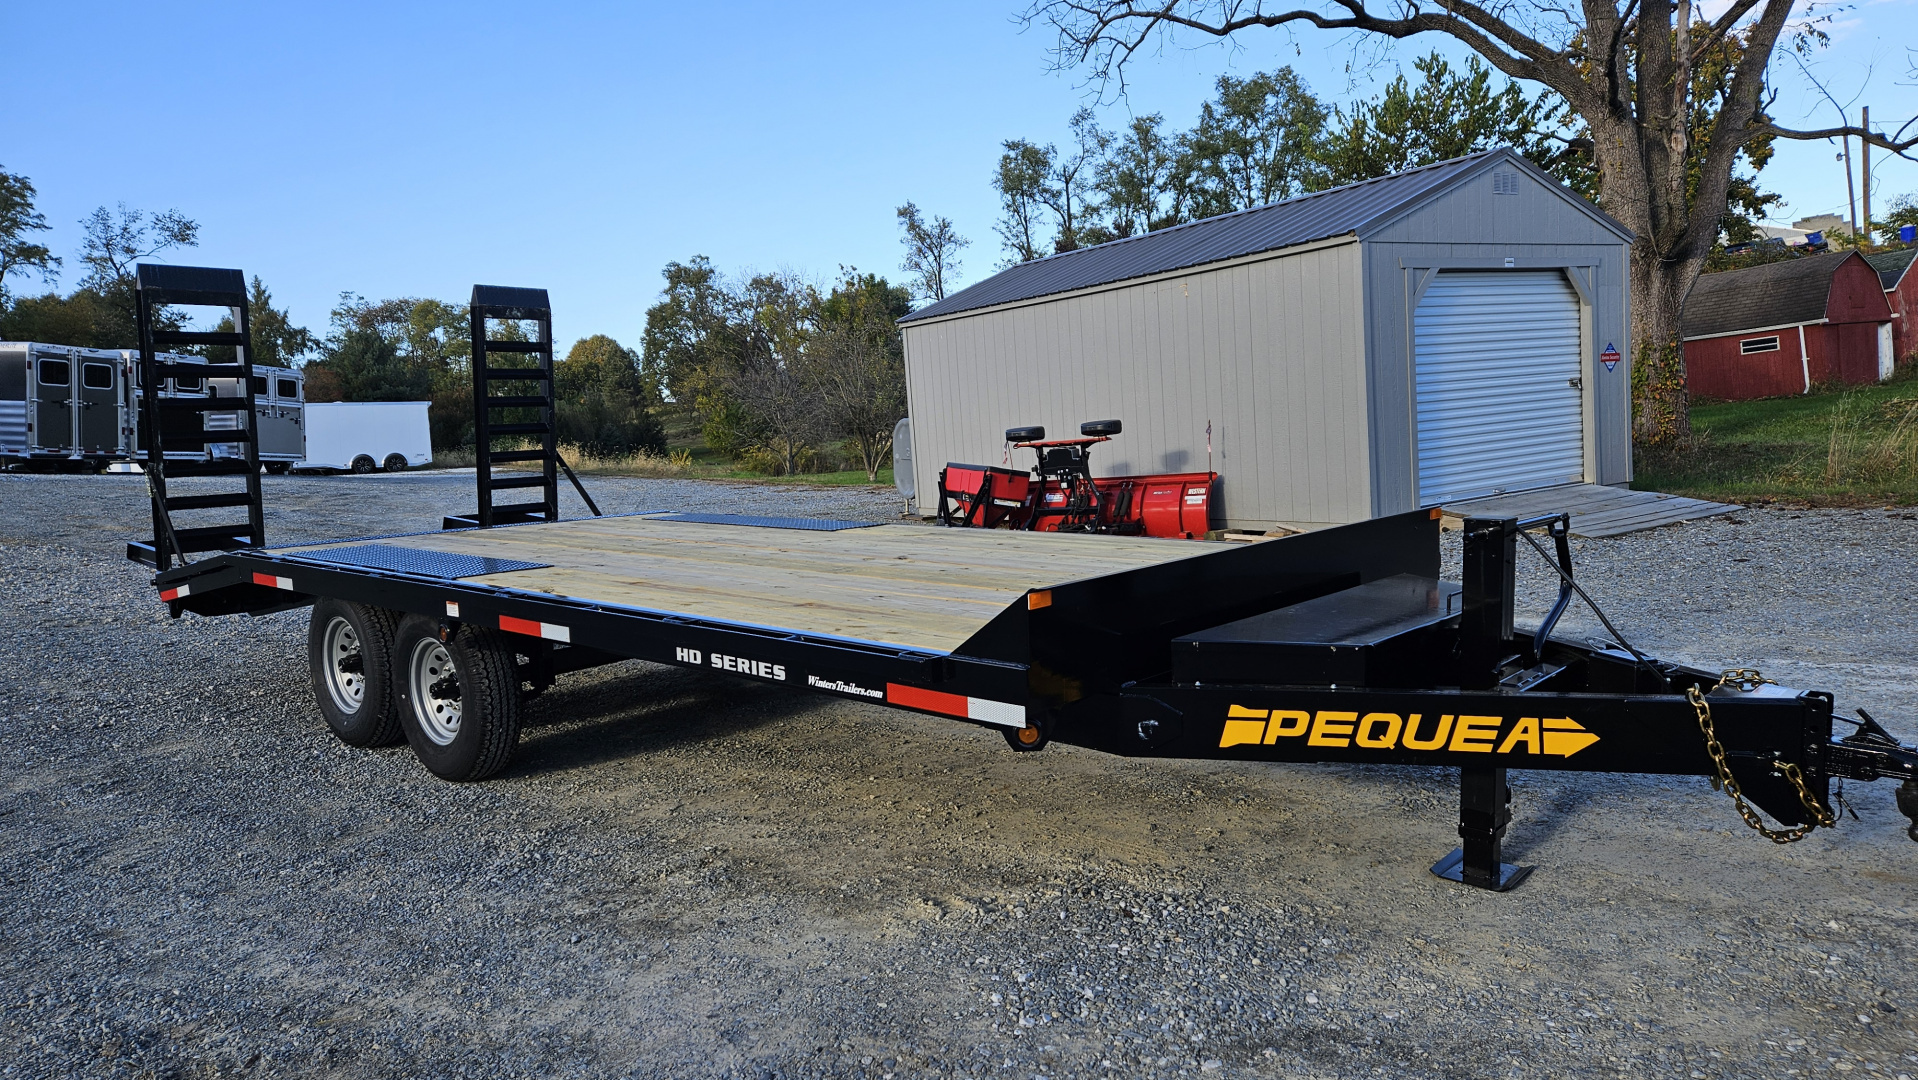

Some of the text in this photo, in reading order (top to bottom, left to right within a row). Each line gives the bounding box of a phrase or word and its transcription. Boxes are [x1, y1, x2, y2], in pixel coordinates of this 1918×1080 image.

[676, 646, 786, 681] HD SERIES
[808, 674, 884, 699] WintersTrailers.com
[1263, 709, 1541, 755] PEQUEA
